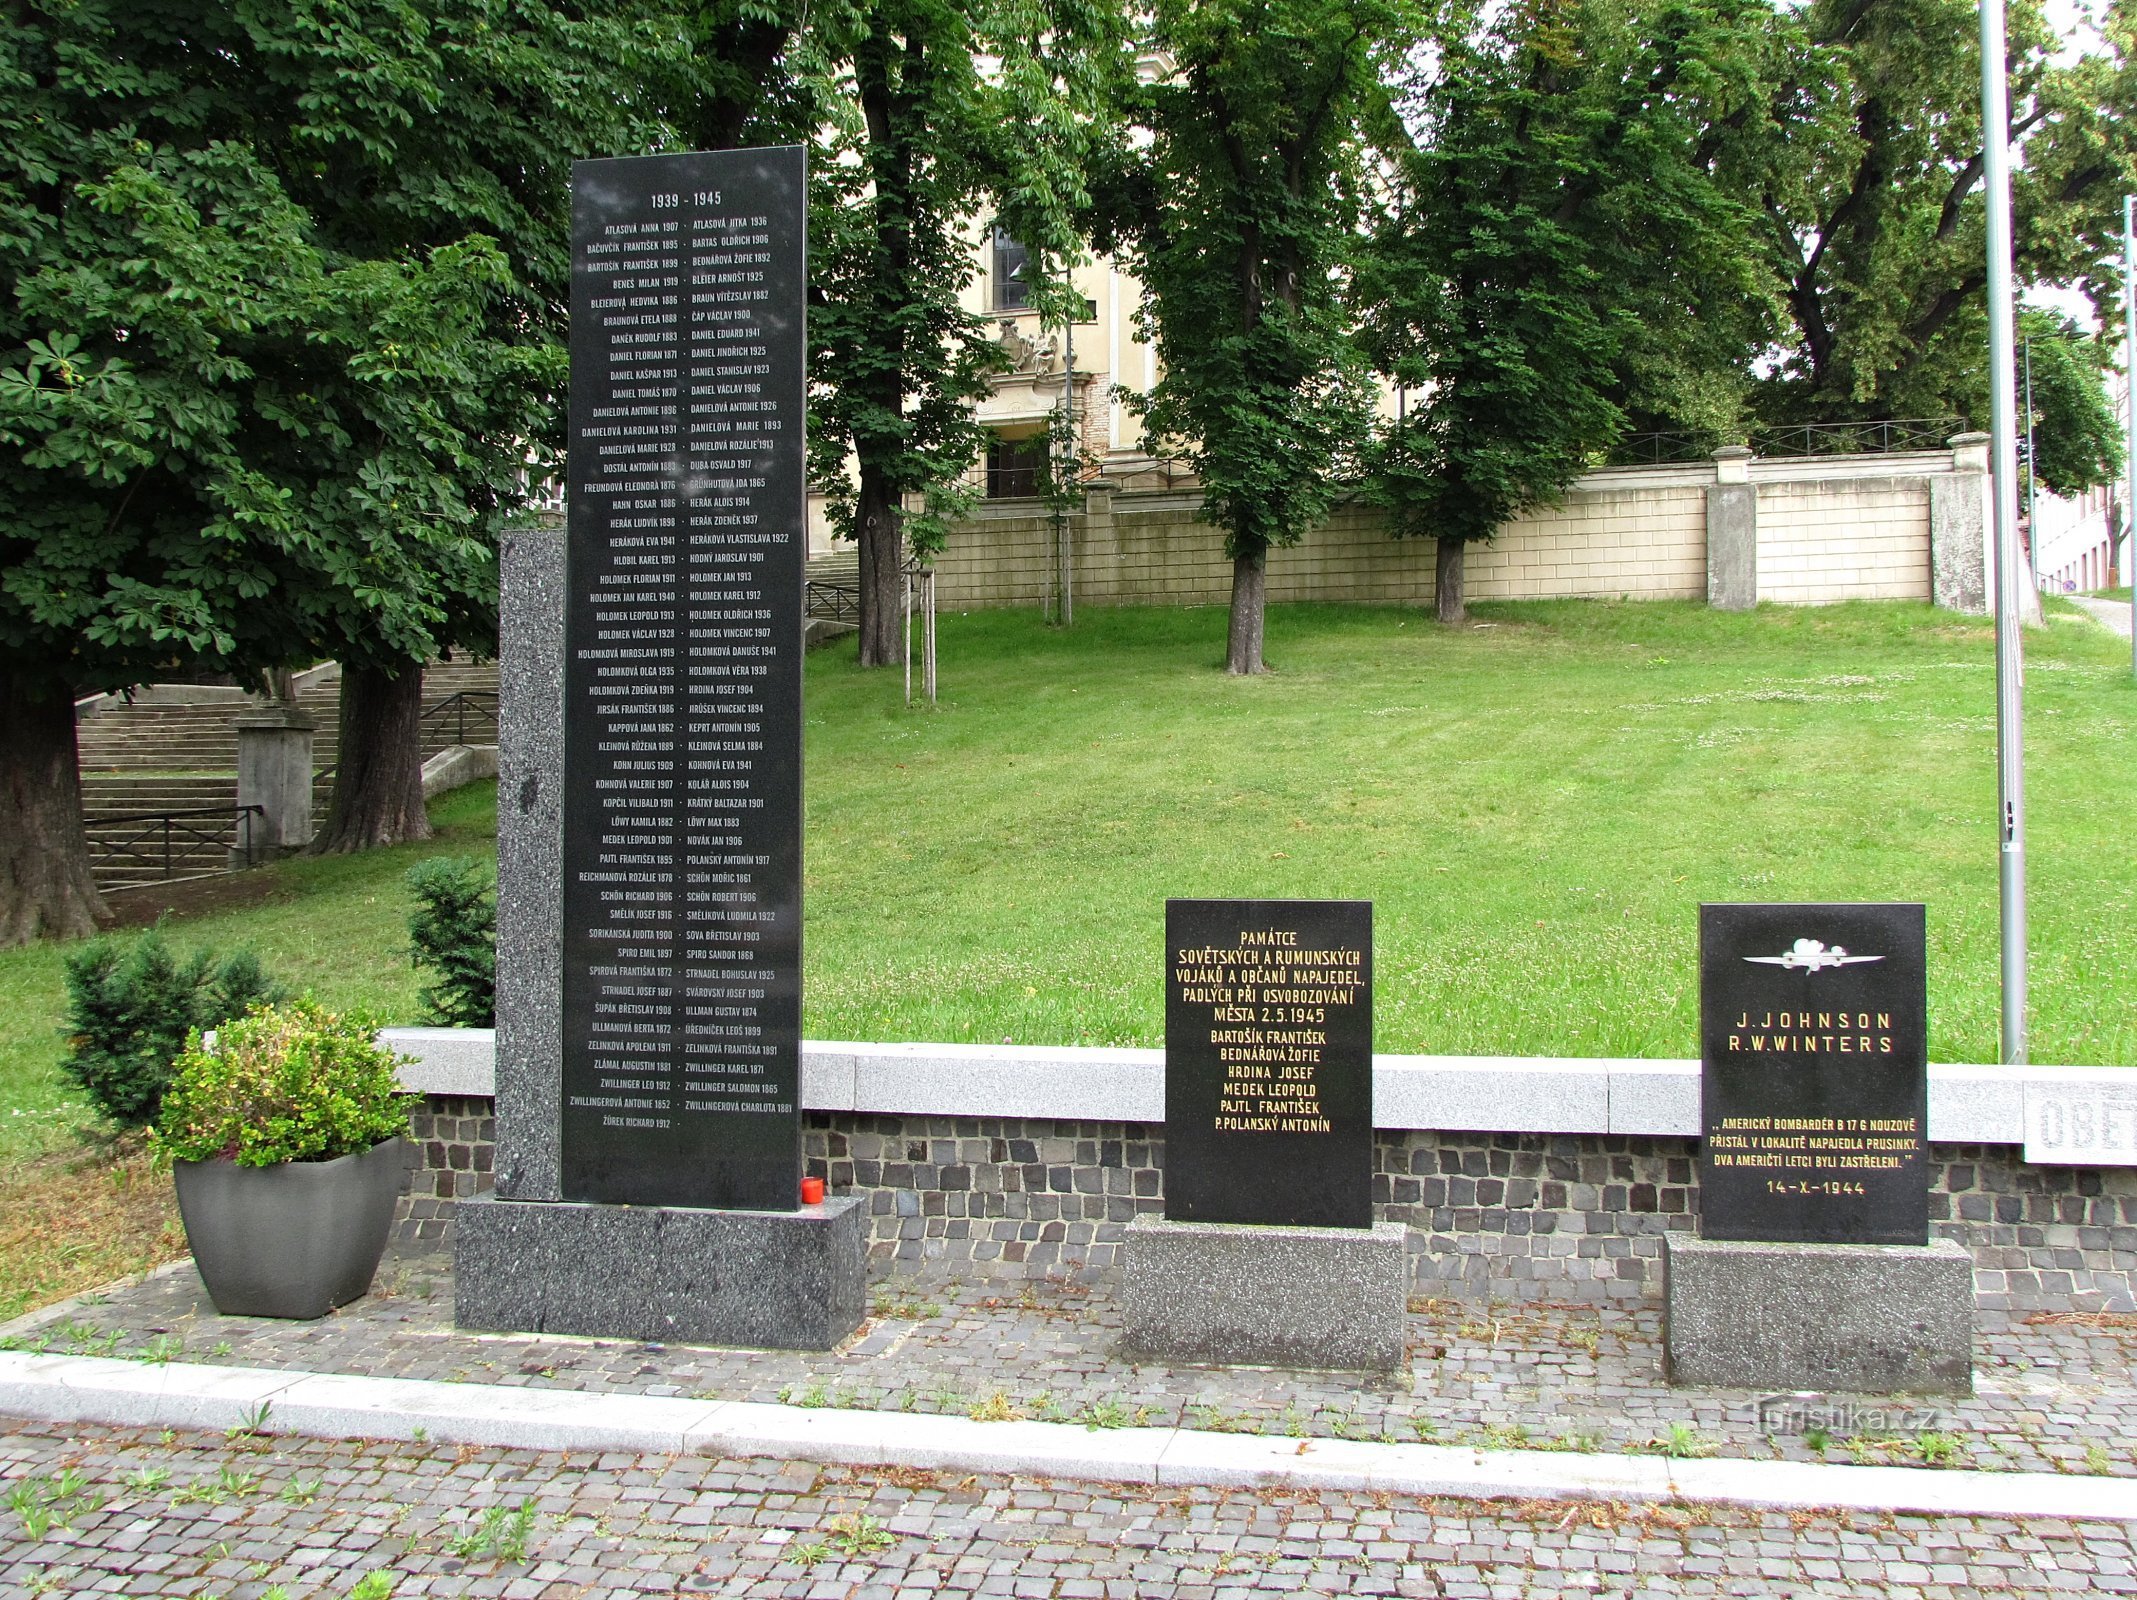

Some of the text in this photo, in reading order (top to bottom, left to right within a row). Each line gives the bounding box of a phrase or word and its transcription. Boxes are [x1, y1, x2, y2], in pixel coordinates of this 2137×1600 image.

[652, 194, 678, 208] 1939
[694, 192, 721, 205] 1945
[693, 217, 767, 229] ATLASOVÁ JITKA 1936
[693, 235, 768, 248] BARTAS OLDŘICH 1906
[639, 279, 660, 287] MILAN
[664, 277, 678, 286] 1919
[693, 271, 763, 284] BLEIER ARNOŠT 1925
[692, 310, 750, 321] ČÁP VÁCLAV 1900
[692, 346, 766, 357] DANIEL JINDŘICH 1925
[692, 365, 769, 377] DANIEL STANISLAV 1923
[691, 401, 776, 413] DANIELOVÁ ANTONIE 1926
[582, 425, 677, 437] DANIELOVÁ KAROLINA 1931
[691, 421, 781, 432] DANIELOVÁ MARIE 1893
[690, 497, 750, 507] HERÁK ALOIS 1914
[690, 533, 789, 544] HERÁKOVÁ VLASTISLAVA 1922
[690, 552, 764, 563] HODNÝ JAROSLAV 1901
[690, 572, 751, 582] HOLOMEK JAN 1913
[599, 628, 674, 639] HOLOMEK VÁCLAV 1928
[690, 628, 770, 638] HOLOMEK VINCENC 1907
[689, 645, 776, 656] HOLOMKOVÁ DANUŠE 1941
[689, 685, 753, 694] HRDINA JOSEF 1904
[689, 721, 760, 732] KEPRT ANTONÍN 1905
[688, 758, 751, 770] KOHNOVÁ EVA 1941
[603, 797, 673, 807] KOPČIL VILIBALD 1911
[688, 797, 764, 808] KRÁTKÝ BALTAZAR 1901
[603, 835, 672, 844] MEDEK LEOPOLD 1901
[687, 891, 756, 901] SCHÖN ROBERT 1906
[687, 930, 759, 941] SOVA BŘETISLAV 1903
[1240, 927, 1297, 945] PAMÁTCE
[687, 950, 706, 959] SPIRO
[709, 951, 736, 959] SANDOR
[1179, 946, 1360, 965] SOVĚTSKÝCH A RUMUNSKÝCH
[589, 965, 672, 976] SPIROVÁ FRANTIŠKA 1872
[1176, 966, 1365, 986] VOJÁKŮ A OBČANŮ NAPAJEDEL,
[602, 986, 635, 995] STRNADEL
[637, 987, 656, 996] JOSEF
[1183, 984, 1354, 1004] PADLÝCH PŘI OSVOBOZOVÁNÍ
[686, 1007, 713, 1015] ULLMAN
[715, 1007, 740, 1016] GUSTAV
[1214, 1003, 1324, 1022] MĚSTA 2.5.1945
[1211, 1028, 1326, 1044] BARTOŠÍK FRANTIŠEK
[1221, 1046, 1320, 1062] BEDNÁŘOVÁ ŽOFIE
[686, 1063, 764, 1074] ZWILLINGER KAREL 1871
[1228, 1066, 1314, 1079] HRDINA JOSEF
[601, 1079, 670, 1090] ZWILLINGER LEO 1912
[1224, 1083, 1316, 1096] MEDEK LEOPOLD
[686, 1100, 739, 1111] ZWILLINGEROVÁ
[741, 1103, 775, 1112] CHARLOTA
[1220, 1098, 1319, 1114] PAJTL FRANTIŠEK
[1774, 1118, 1834, 1130] BOMBARDÉR
[1837, 1120, 1843, 1130] B
[1846, 1120, 1857, 1130] 17
[1860, 1120, 1866, 1130] G
[1870, 1118, 1916, 1131] NOUZOVĚ
[1710, 1135, 1919, 1150] PŘISTÁL V LOKALITĚ NAPAJEDLA PRUSINKY.
[1714, 1155, 1733, 1166] DVA
[1736, 1153, 1782, 1167] AMERIČTÍ
[1786, 1156, 1812, 1167] LETCI
[1816, 1157, 1836, 1168] BYLI
